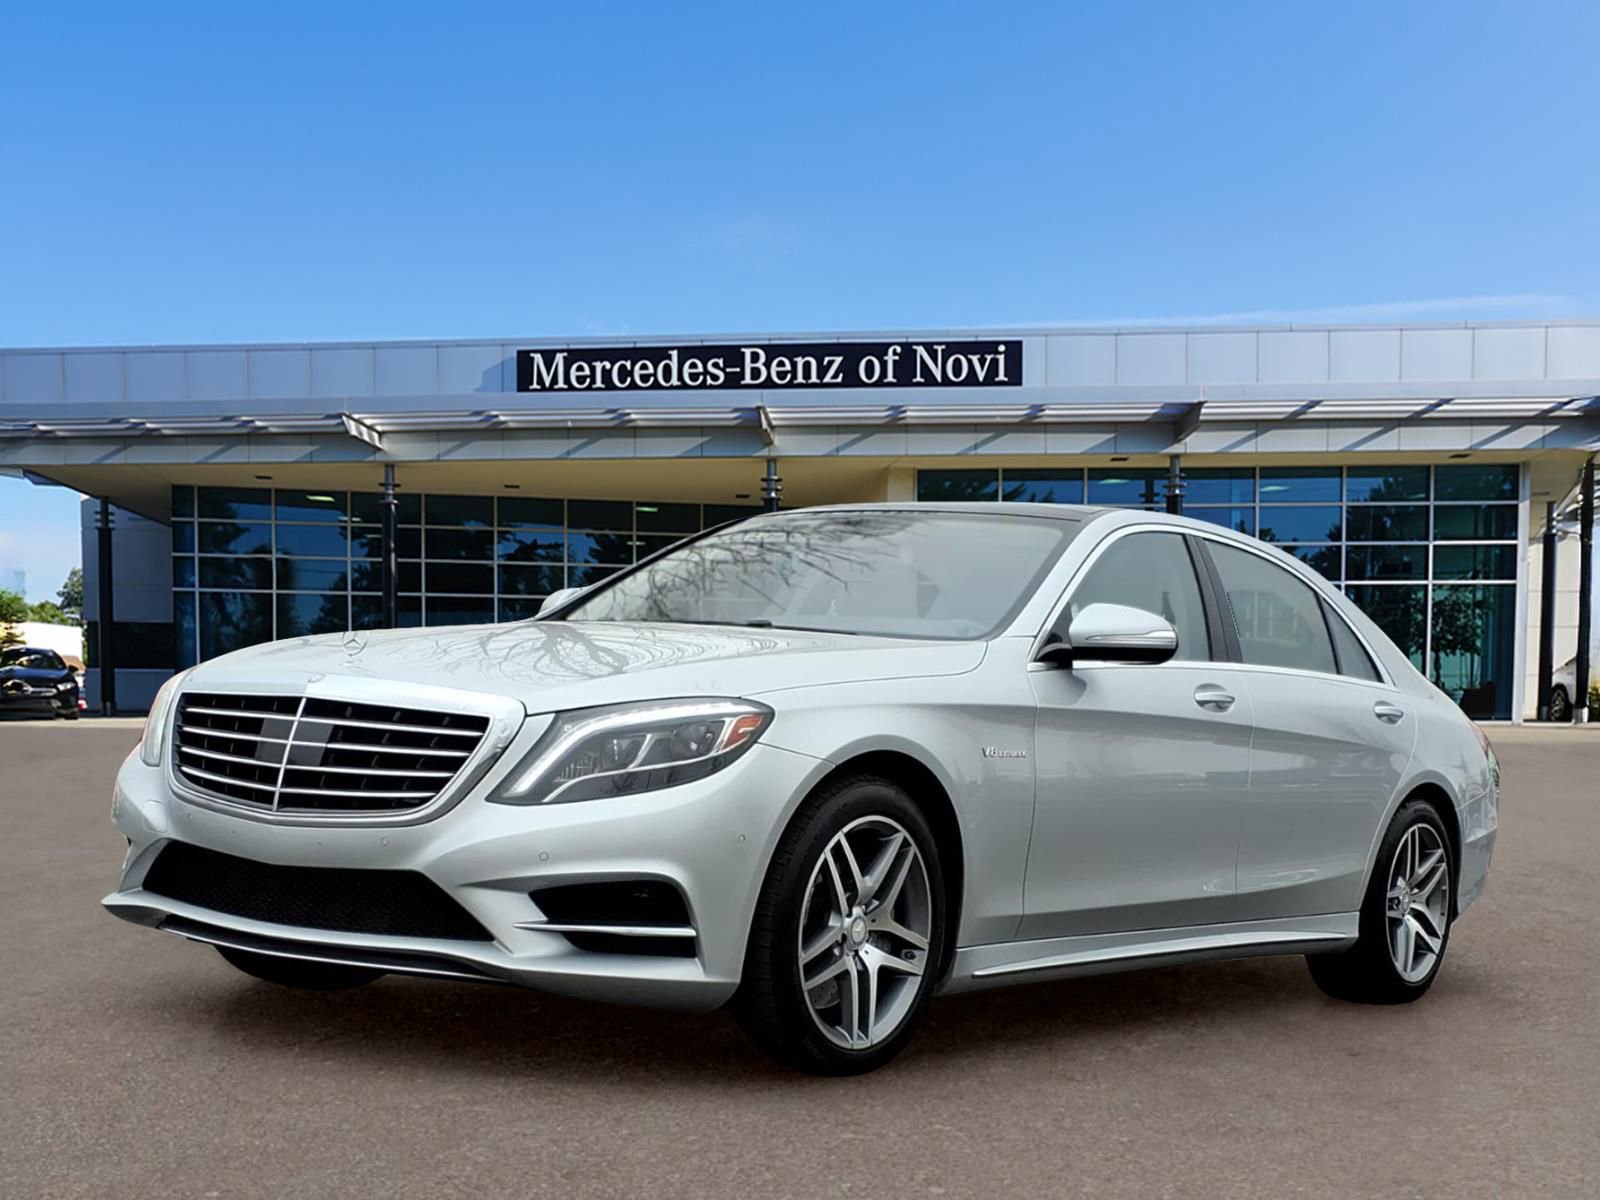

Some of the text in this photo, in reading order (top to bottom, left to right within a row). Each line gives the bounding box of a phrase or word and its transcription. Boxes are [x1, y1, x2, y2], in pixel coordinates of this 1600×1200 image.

[529, 344, 1009, 390] Mercedes-Benz of Novi
